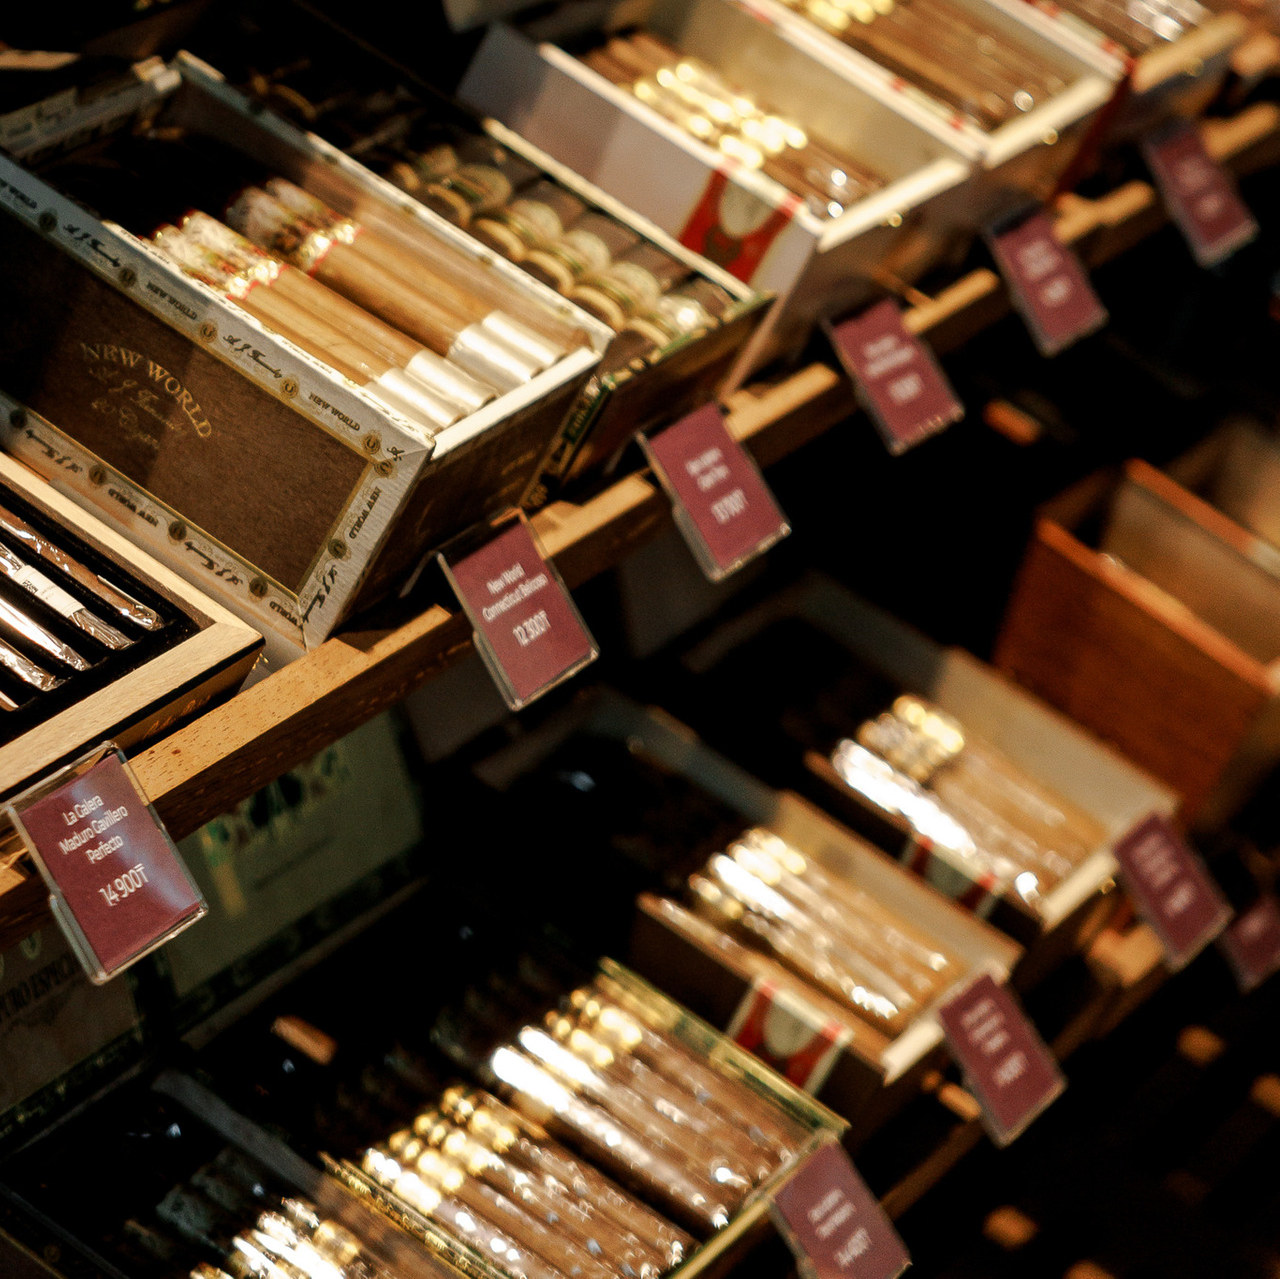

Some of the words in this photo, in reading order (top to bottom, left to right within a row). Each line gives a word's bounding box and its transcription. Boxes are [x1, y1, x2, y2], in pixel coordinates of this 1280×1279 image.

[8, 185, 38, 209] WORLD
[146, 281, 168, 300] NEW
[169, 297, 198, 320] WORLD
[79, 342, 144, 368] NEW
[147, 359, 212, 438] WORLD
[308, 392, 331, 413] NEW
[331, 407, 361, 432] WORLD
[366, 486, 383, 512] NEW
[348, 509, 369, 540] WORLD
[486, 577, 507, 595] New
[501, 562, 526, 585] World
[269, 600, 299, 625] WORLD
[512, 625, 529, 647] 12
[63, 811, 79, 827] La
[74, 795, 105, 819] Galera
[59, 827, 95, 856] Maduro
[91, 805, 128, 835] Gavillero
[85, 835, 125, 864] Perfecto
[98, 883, 119, 907] 14
